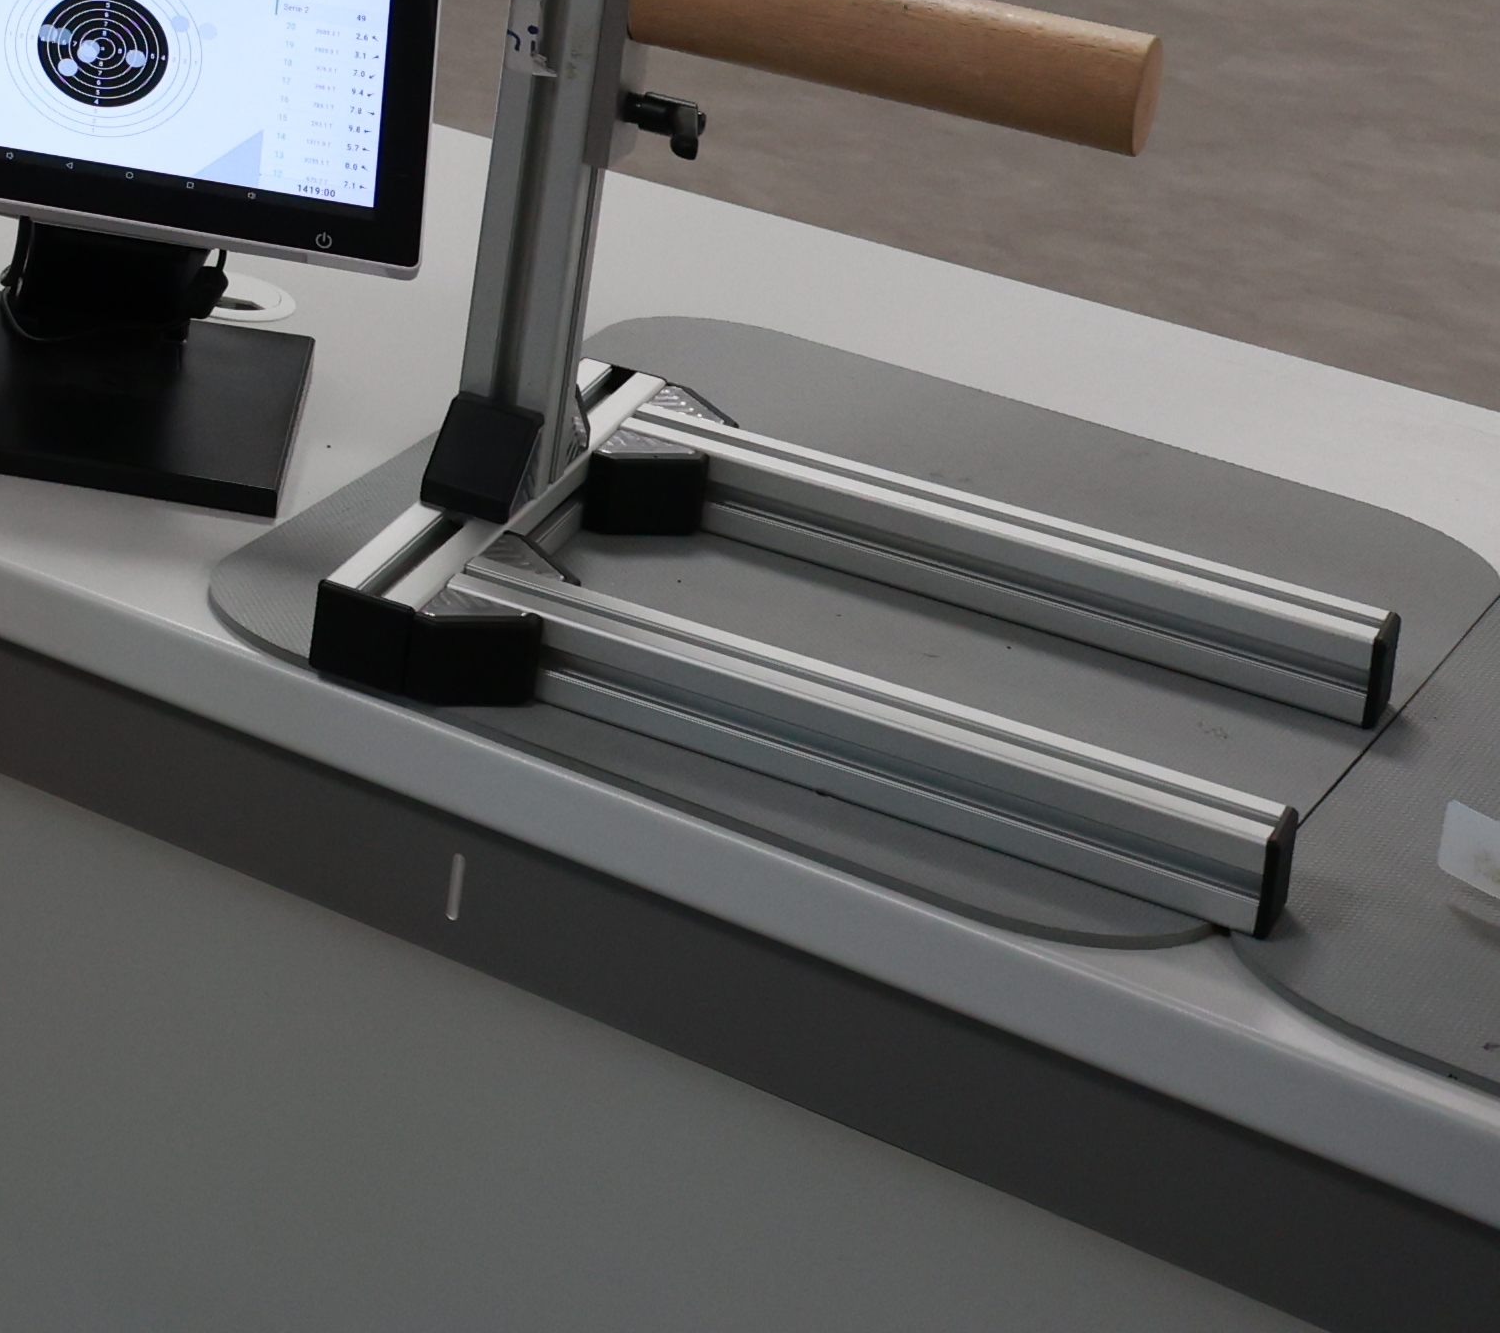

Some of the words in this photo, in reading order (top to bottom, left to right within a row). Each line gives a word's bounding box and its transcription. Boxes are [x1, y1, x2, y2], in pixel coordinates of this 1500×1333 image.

[283, 3, 303, 13] Serie
[304, 6, 310, 14] 2
[356, 14, 367, 22] 49
[355, 32, 369, 41] 2.6
[354, 51, 366, 60] 3.1
[353, 69, 366, 78] 7.0
[351, 87, 364, 96] 9.4
[346, 143, 360, 152] 5.7
[297, 184, 336, 198] 1419:00
